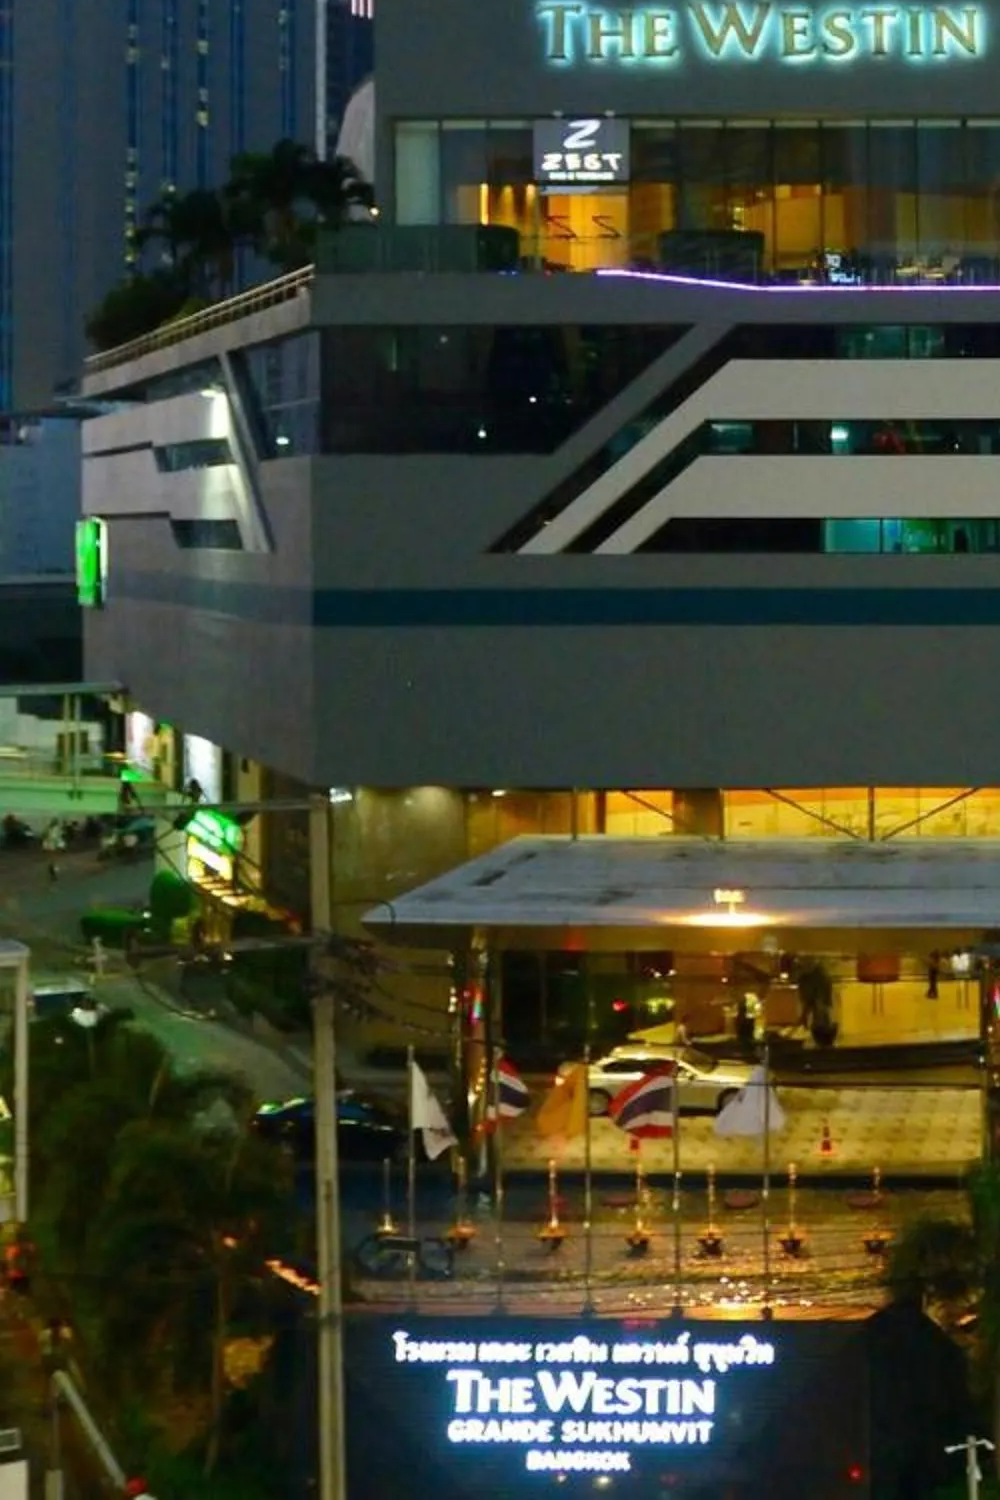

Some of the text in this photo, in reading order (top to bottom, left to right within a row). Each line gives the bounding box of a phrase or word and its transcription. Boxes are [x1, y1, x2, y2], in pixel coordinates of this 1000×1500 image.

[537, 0, 680, 59] THE
[446, 1369, 716, 1415] THE WESTIN
[447, 1419, 714, 1444] GRANDE SUKHUMVIT
